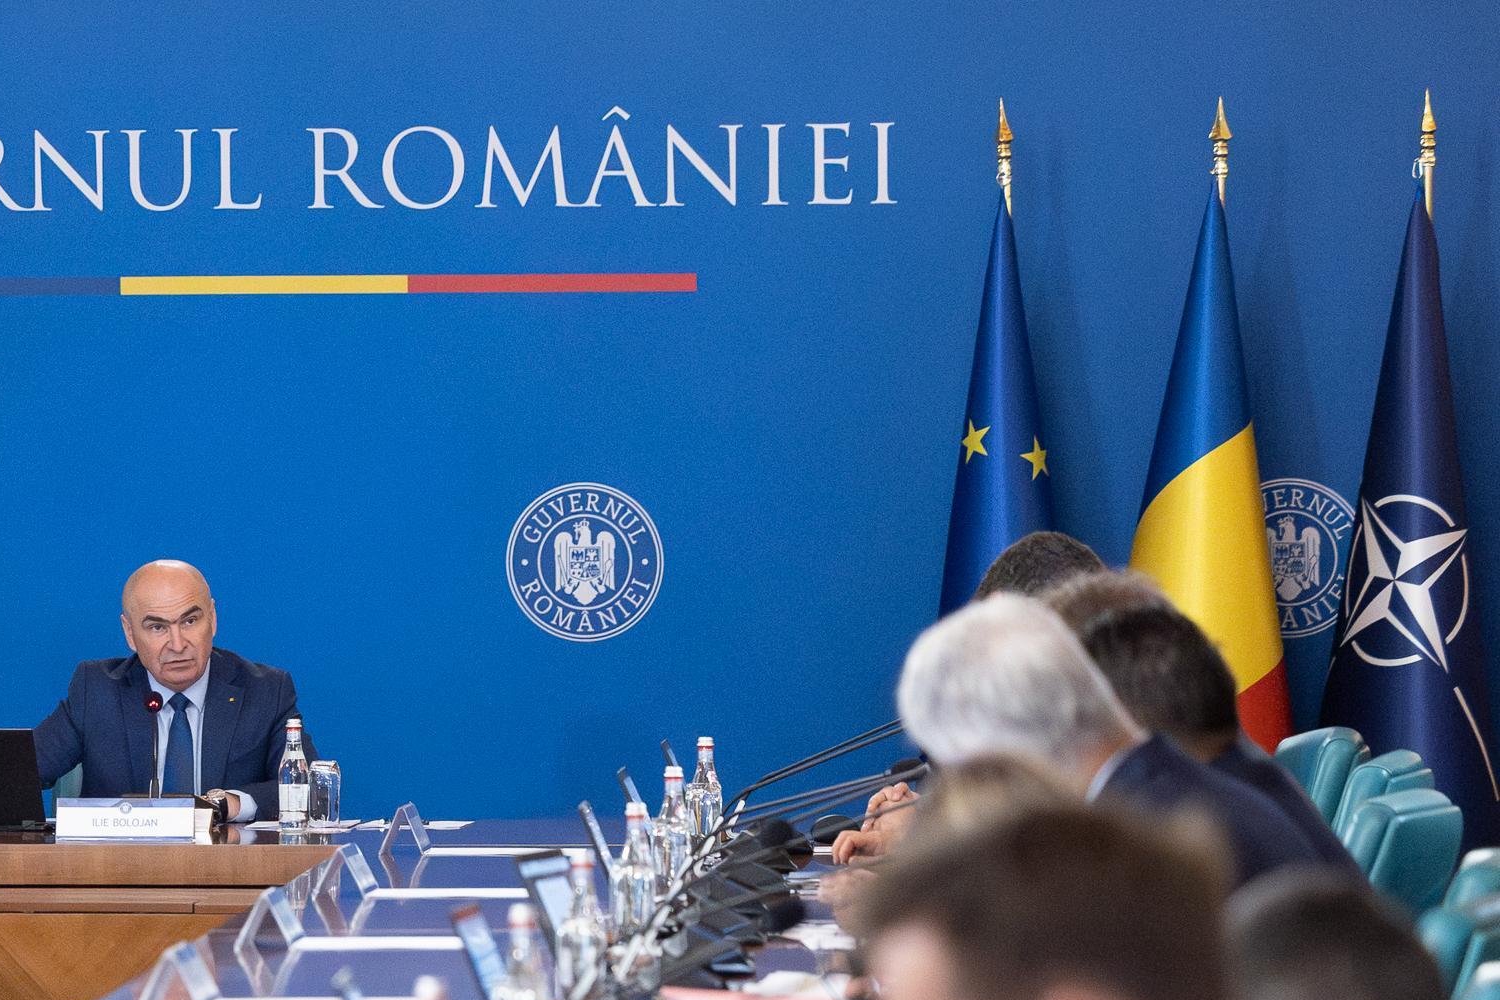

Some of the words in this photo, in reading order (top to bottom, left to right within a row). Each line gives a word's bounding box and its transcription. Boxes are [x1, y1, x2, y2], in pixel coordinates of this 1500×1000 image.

[307, 106, 898, 211] ROMÂNIEI
[522, 492, 646, 545] GUVERNUL
[520, 577, 651, 632] ROMÂNIEI
[92, 818, 109, 827] ILIE
[112, 817, 158, 827] BOLOJAN
